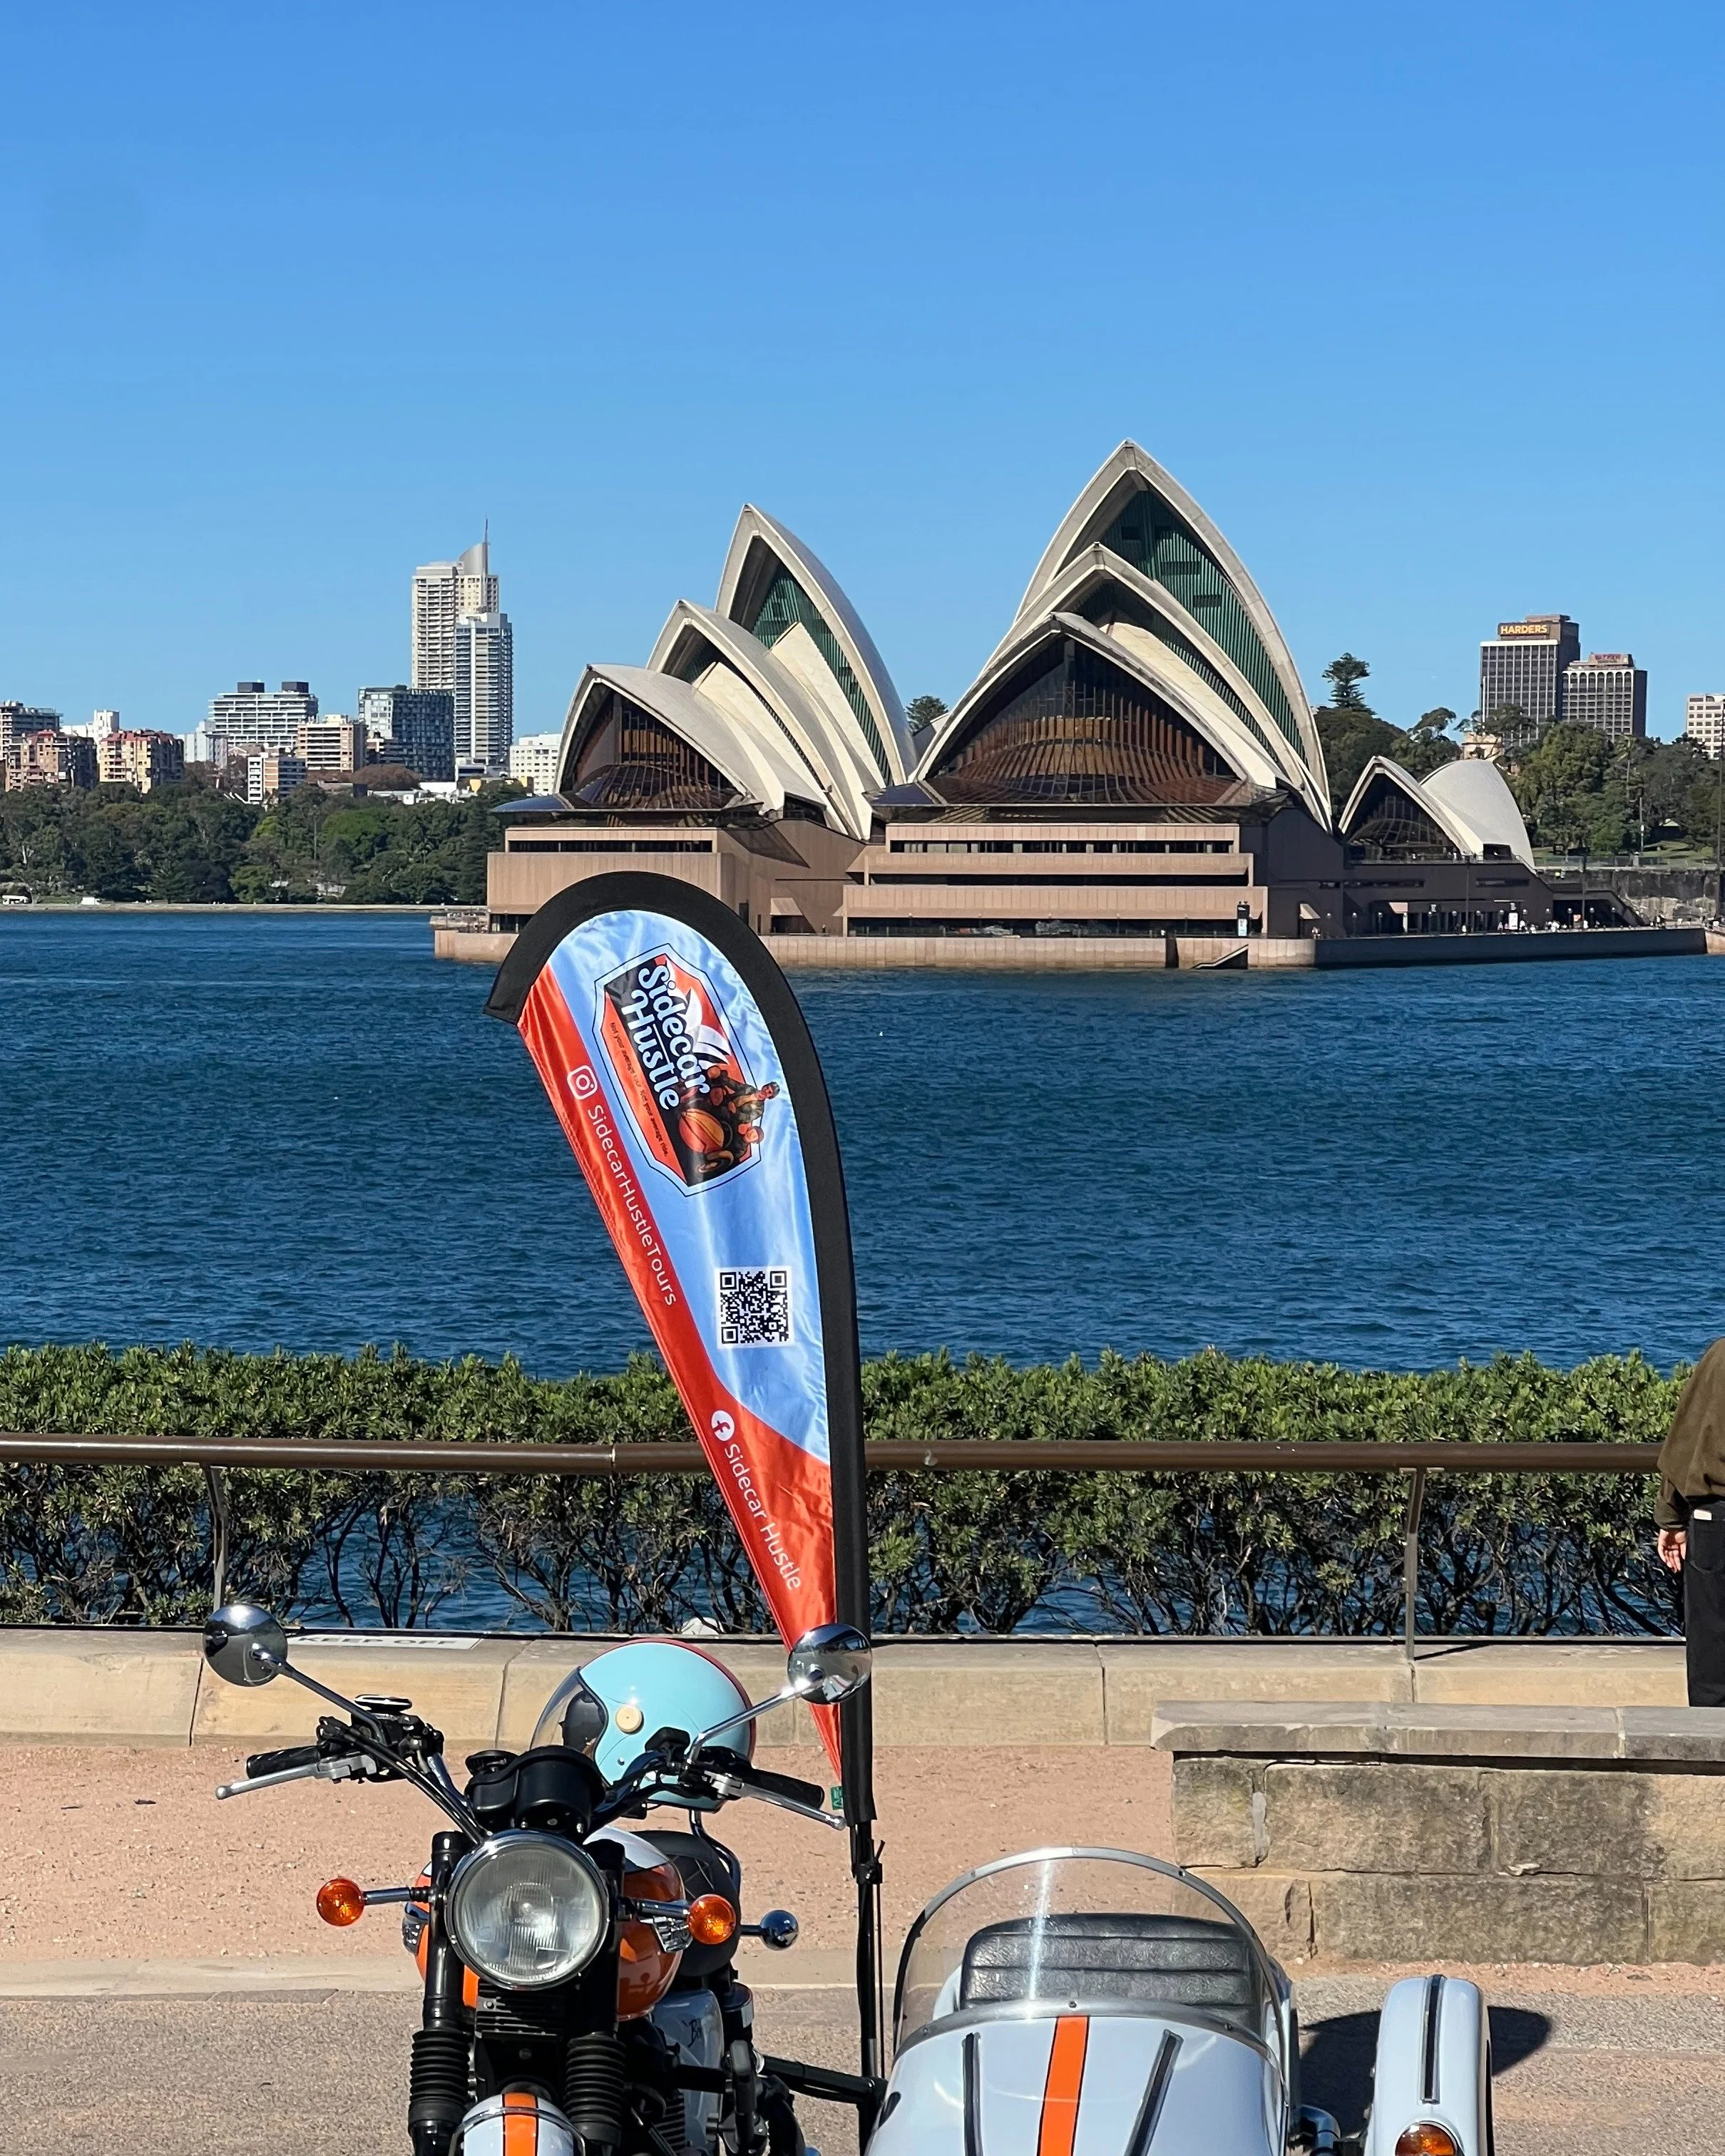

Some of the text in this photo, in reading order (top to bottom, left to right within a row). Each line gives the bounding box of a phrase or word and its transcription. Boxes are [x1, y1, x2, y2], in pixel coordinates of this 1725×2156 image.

[1500, 625, 1547, 634] HARDERS
[621, 990, 680, 1109] Hustle
[638, 965, 710, 1094] Sidecar
[588, 1104, 677, 1306] SidecarHustleTours
[725, 1443, 767, 1519] Sidecar
[760, 1522, 802, 1591] Hustle
